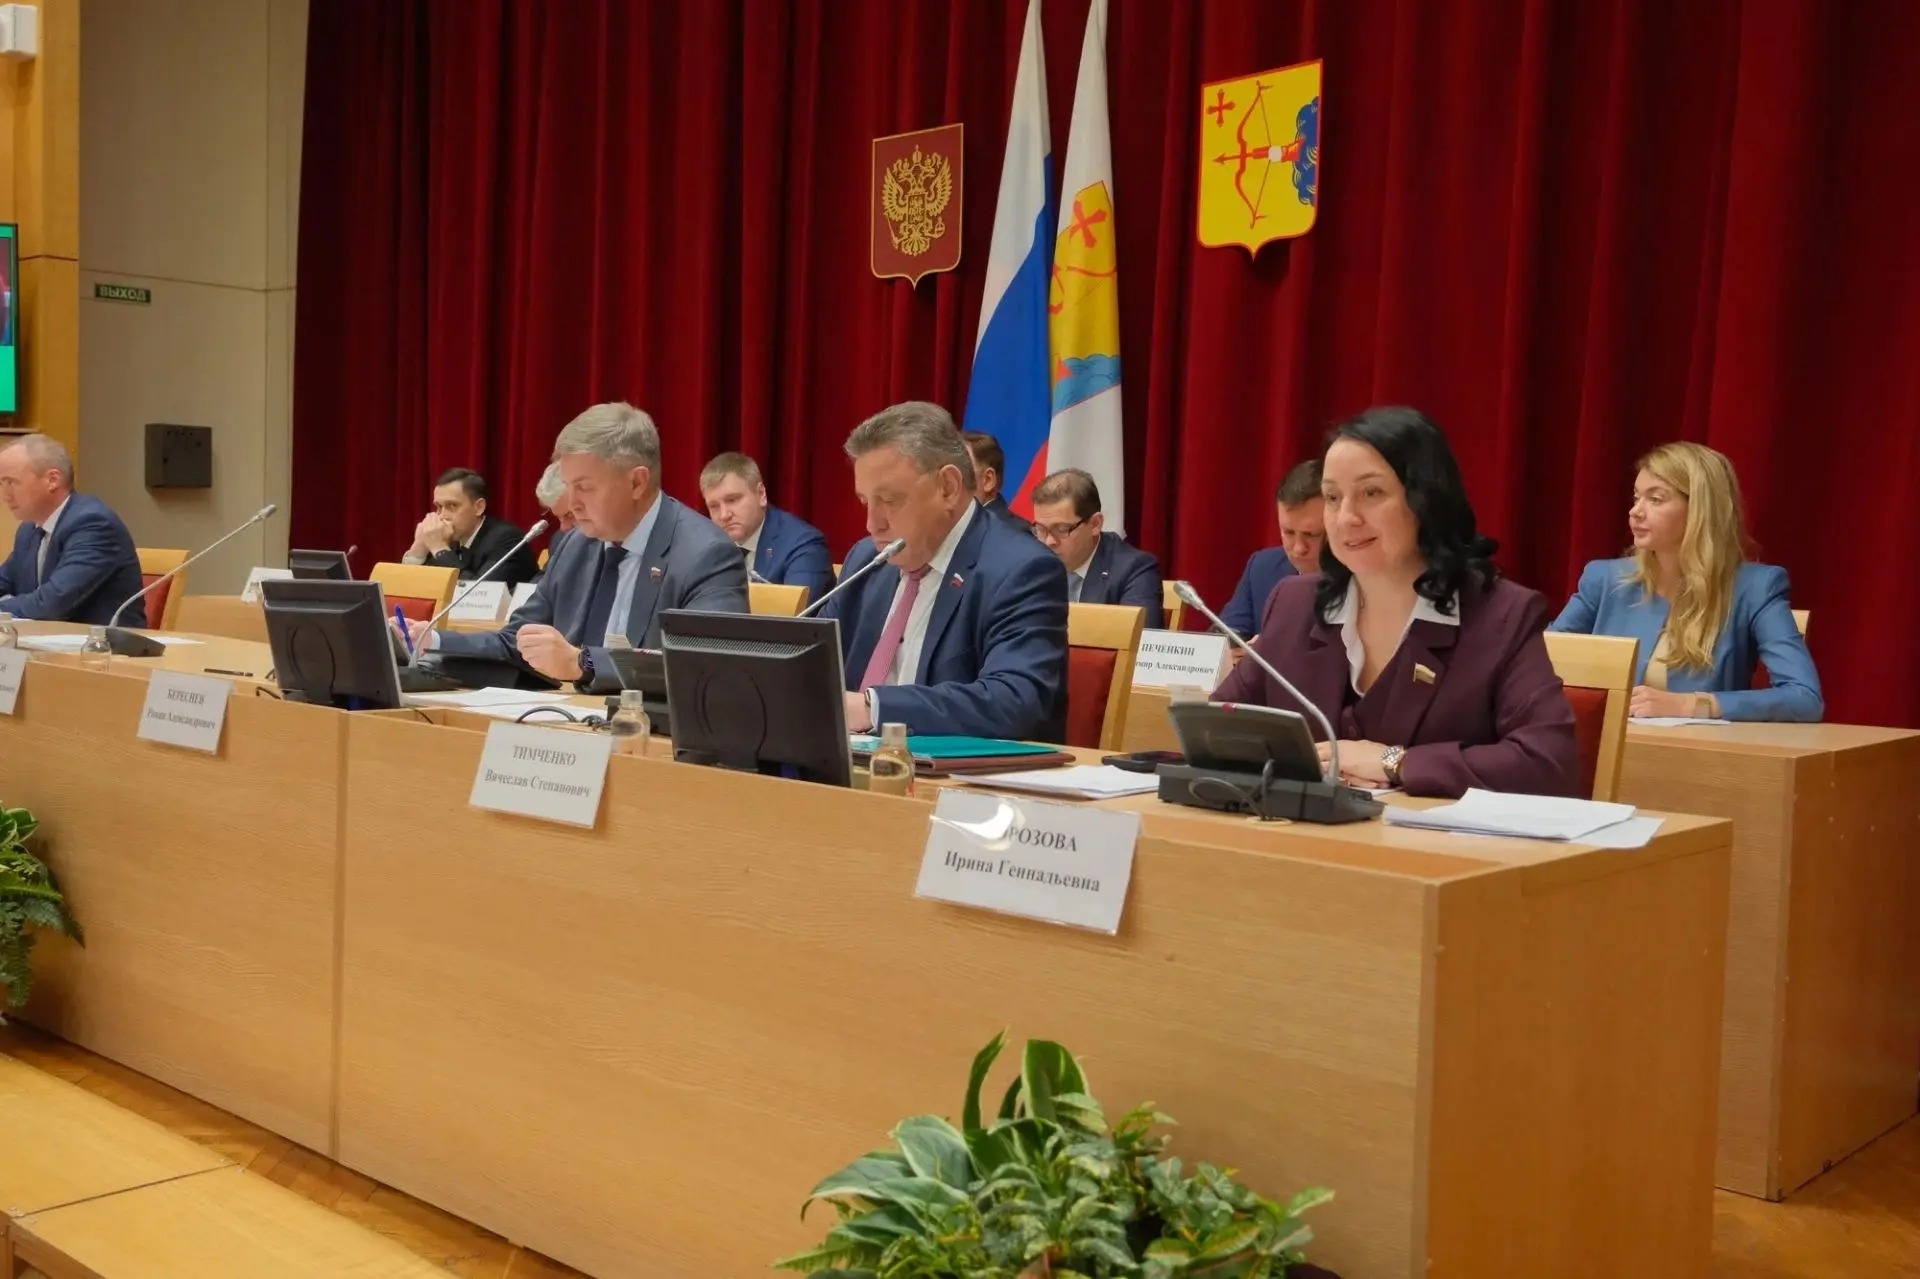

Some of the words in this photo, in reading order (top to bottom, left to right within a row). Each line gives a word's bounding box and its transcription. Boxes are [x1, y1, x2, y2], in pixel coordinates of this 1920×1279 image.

[100, 286, 147, 302] ВЫХОД
[1141, 643, 1195, 656] ПЕЧЕНКИН
[512, 745, 577, 767] ТИМЧЕНКО
[485, 769, 528, 788] Вячеслав
[530, 775, 590, 797] Степанович
[1001, 826, 1077, 852] РОЗОВА
[944, 851, 993, 872] Ирина
[998, 859, 1100, 892] Геннадьевна
